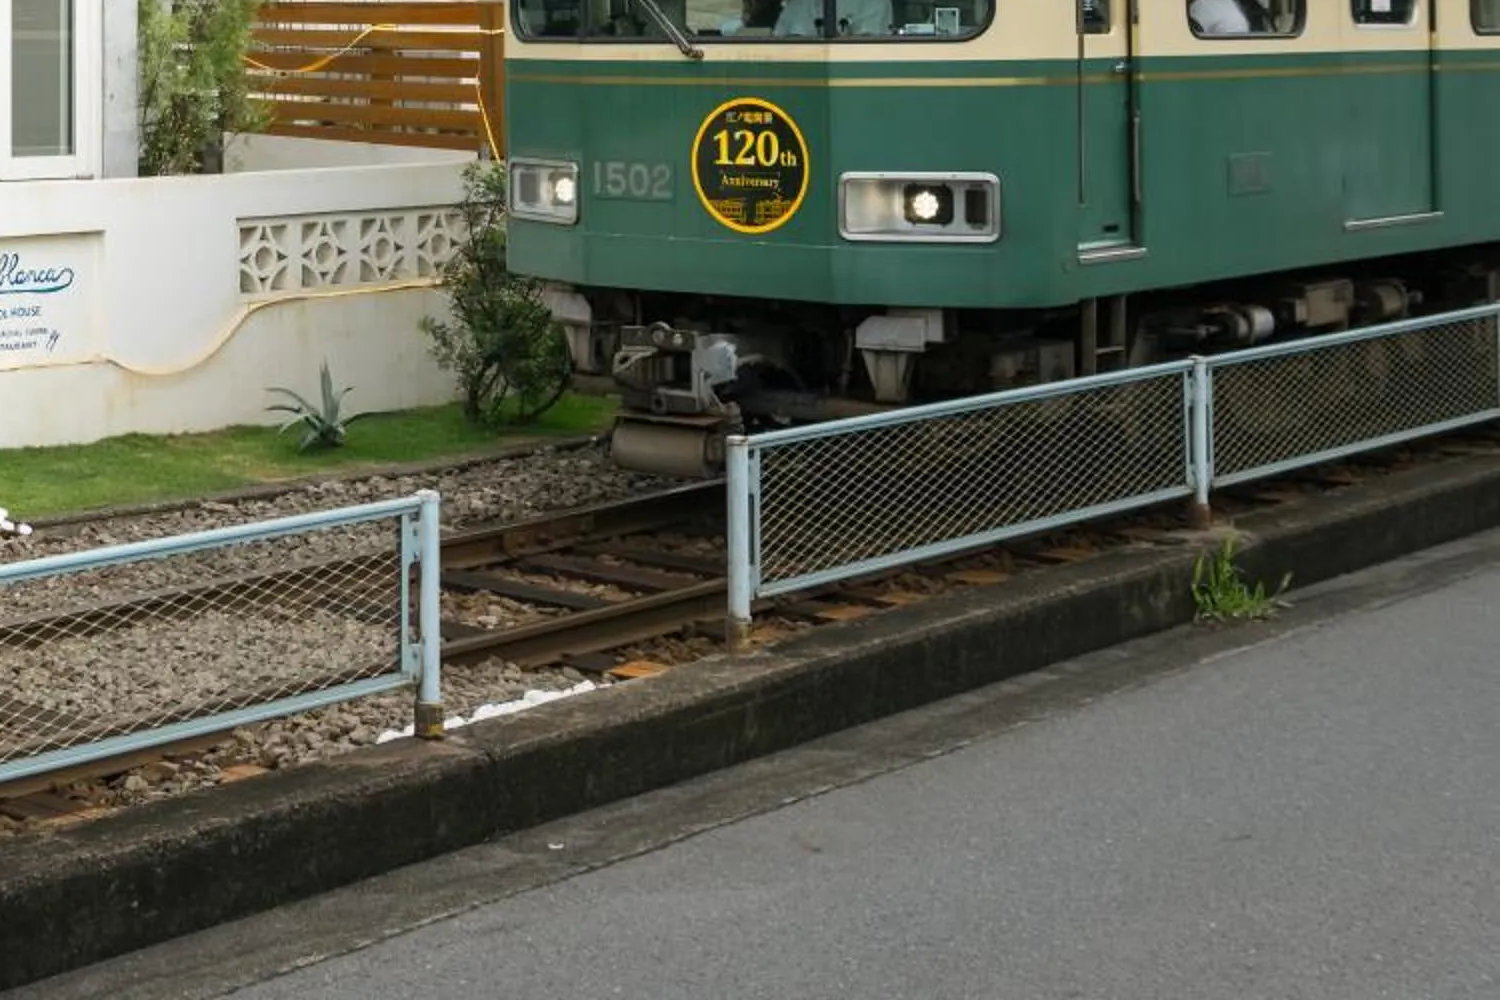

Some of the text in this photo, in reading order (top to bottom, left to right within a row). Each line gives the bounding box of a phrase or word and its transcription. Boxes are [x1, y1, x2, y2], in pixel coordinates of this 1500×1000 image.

[713, 128, 798, 168] 120th
[593, 160, 673, 199] 1502
[721, 173, 780, 189] Anniversary
[10, 305, 42, 318] HOUSE
